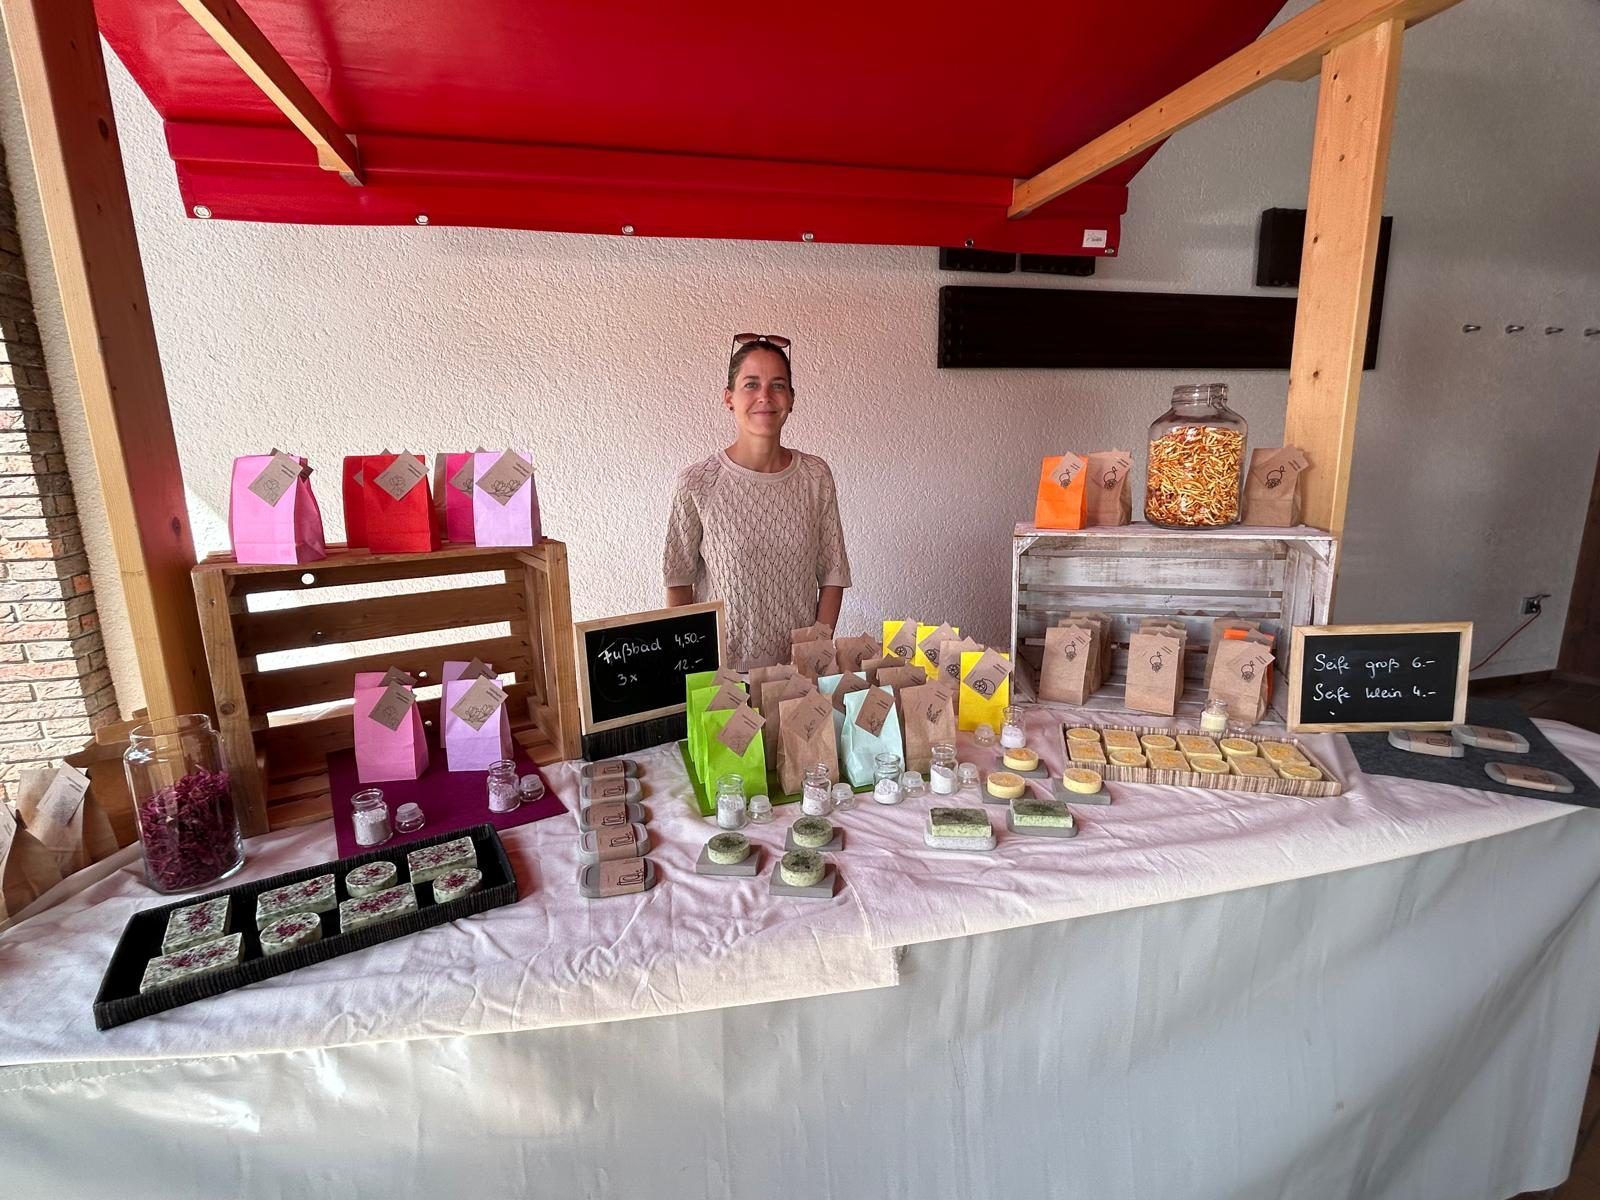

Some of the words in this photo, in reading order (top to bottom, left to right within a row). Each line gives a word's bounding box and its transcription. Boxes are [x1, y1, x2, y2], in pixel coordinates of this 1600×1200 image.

[598, 638, 662, 664] Fußbad
[1313, 653, 1350, 675] Seife
[1365, 658, 1400, 679] groß
[1313, 683, 1351, 704] Seife
[1366, 687, 1402, 699] klein
